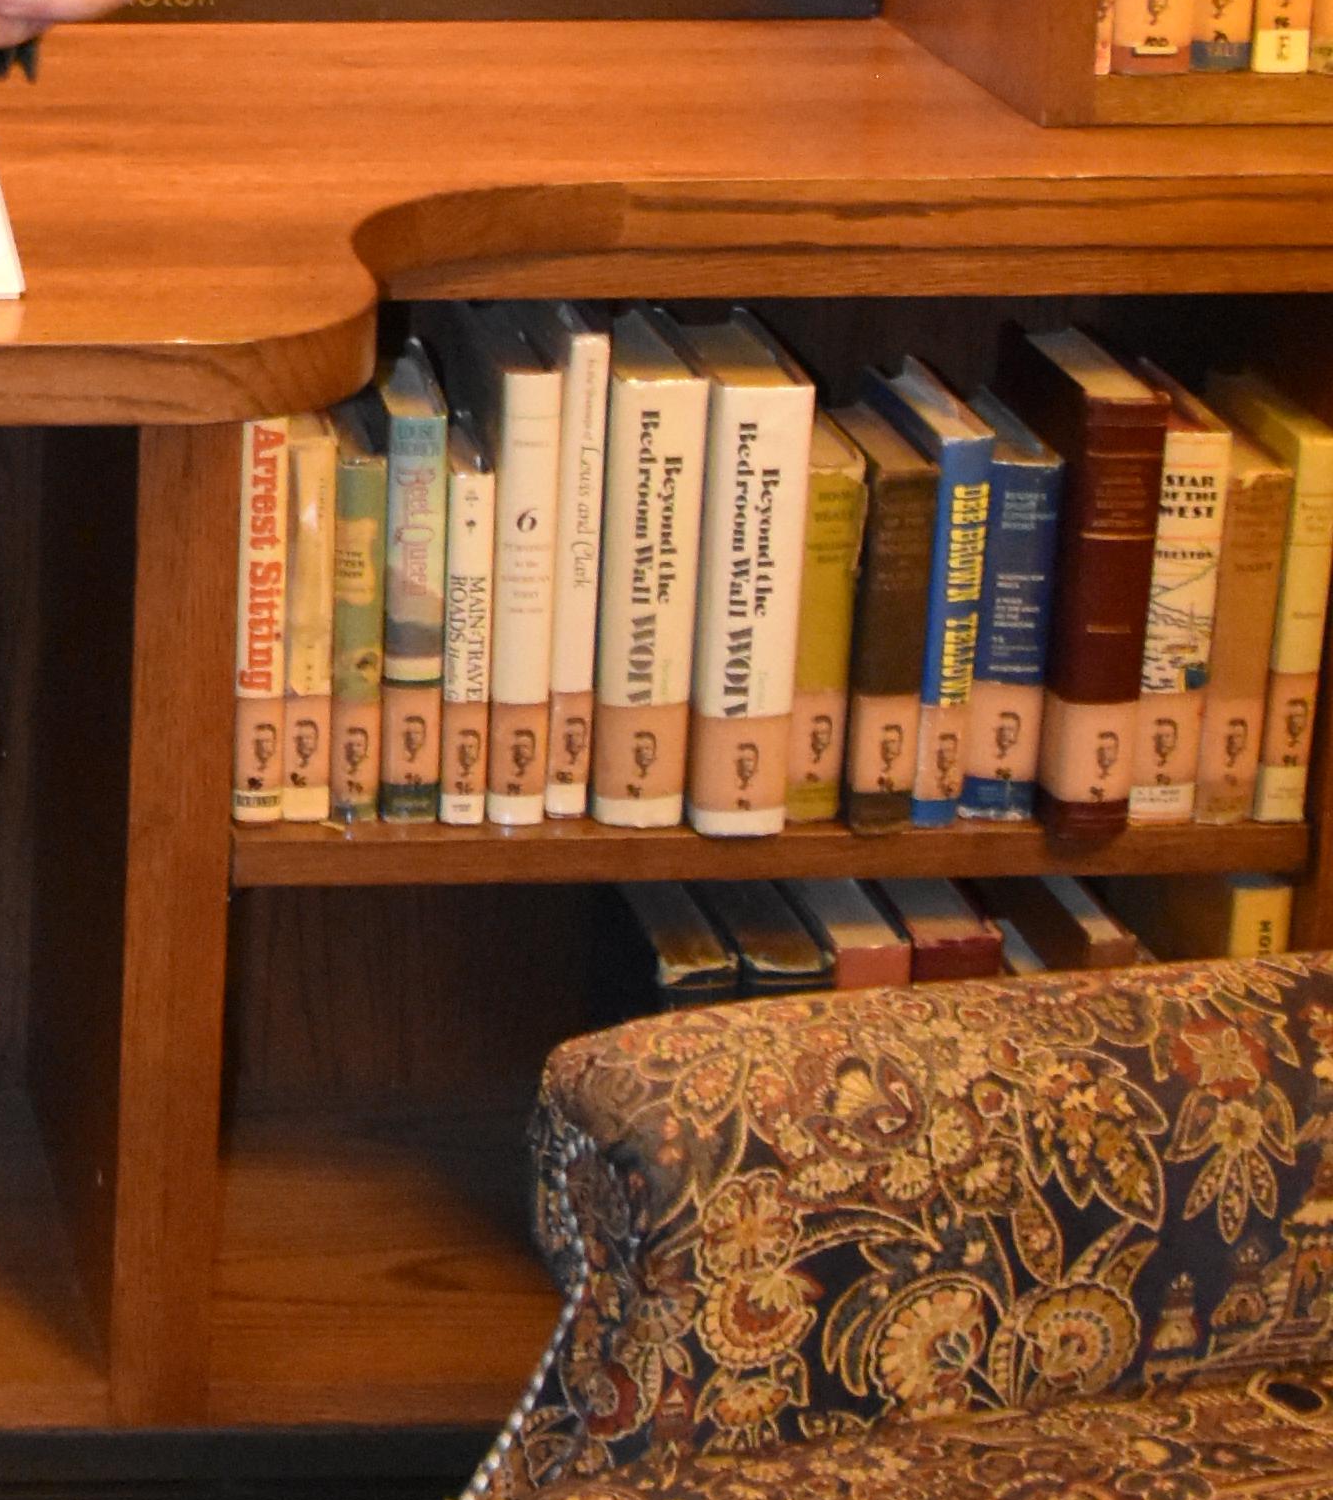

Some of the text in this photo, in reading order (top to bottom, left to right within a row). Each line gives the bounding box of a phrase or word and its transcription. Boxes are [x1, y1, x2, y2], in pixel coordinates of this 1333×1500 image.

[634, 409, 661, 541] Bedroom
[656, 455, 684, 606] Beyond the
[731, 421, 759, 553] Bedroom
[1164, 473, 1215, 489] STAR
[239, 425, 286, 693] Arrest Sitting
[448, 574, 470, 644] ROADS
[631, 544, 655, 606] Wall
[728, 557, 752, 620] Wall
[753, 468, 781, 618] Beyond the
